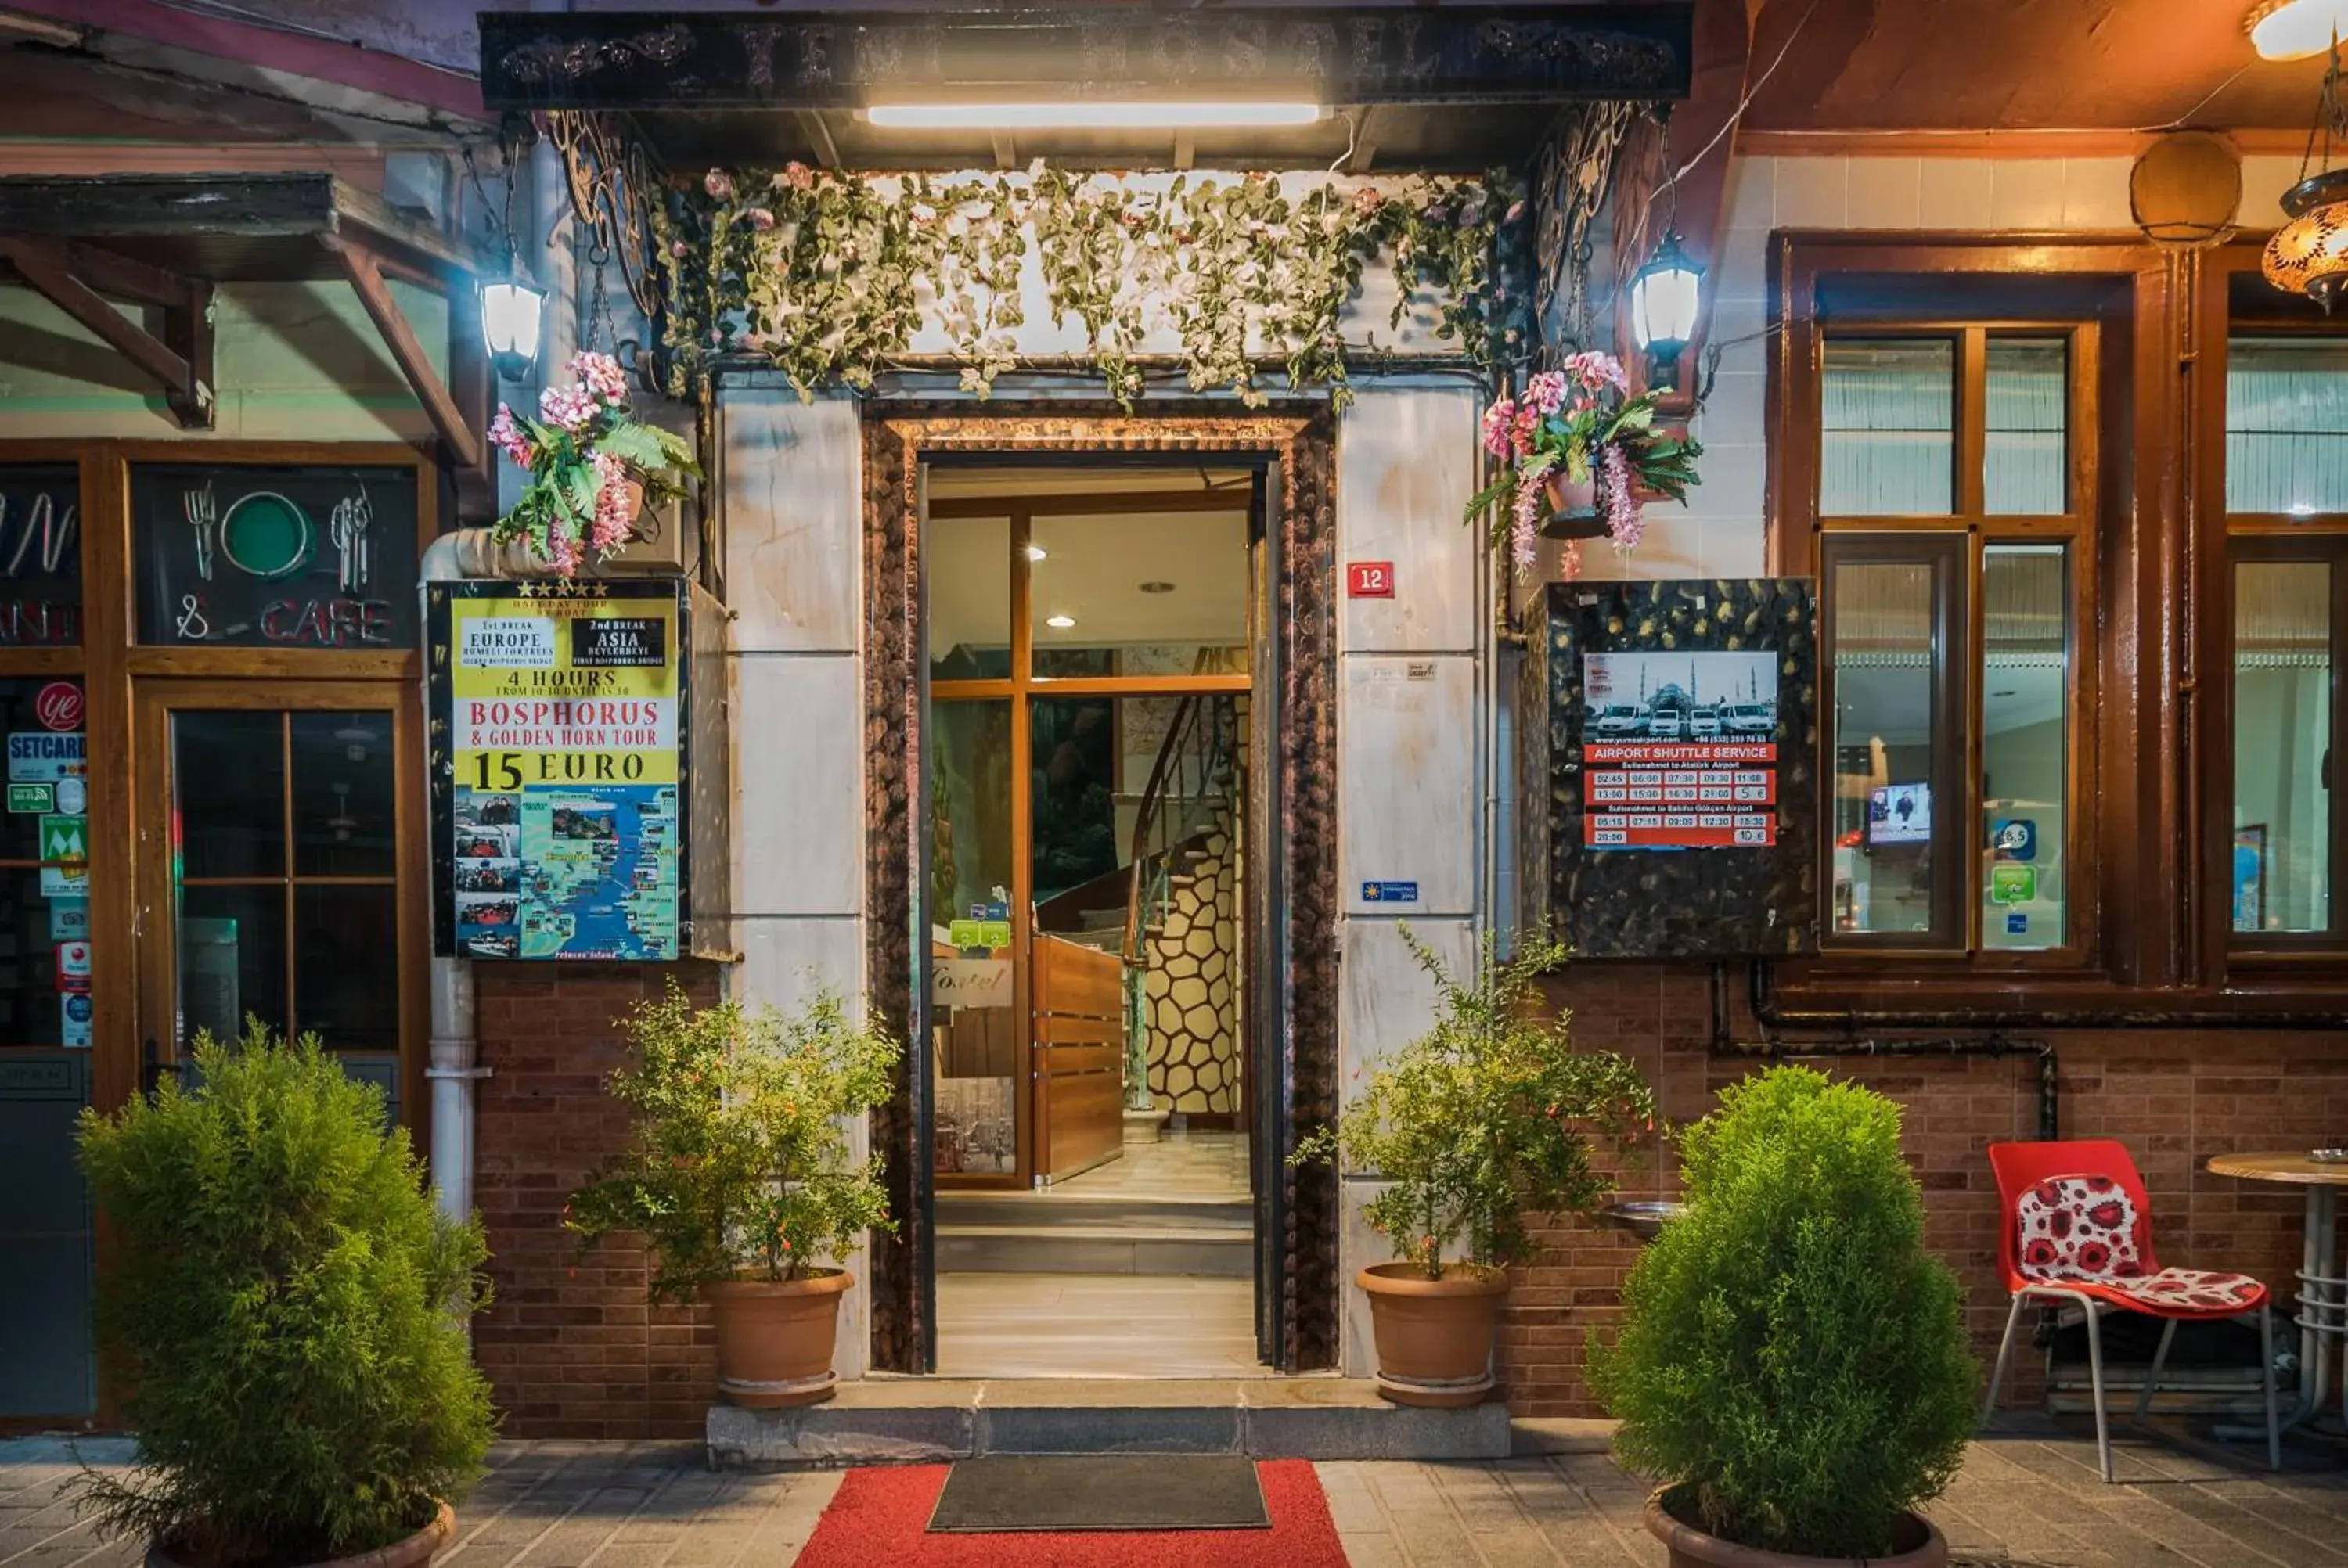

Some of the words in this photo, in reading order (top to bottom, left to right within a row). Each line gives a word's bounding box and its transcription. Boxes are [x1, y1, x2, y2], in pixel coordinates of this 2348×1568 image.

[1361, 569, 1382, 589] 12
[177, 594, 208, 638] &
[261, 599, 391, 646] CAFE
[502, 621, 533, 630] BREAK
[589, 620, 610, 631] 2nd
[613, 620, 646, 631] BREAK
[470, 633, 541, 647] EUROPE
[597, 632, 639, 647] ASIA
[508, 671, 519, 686] 4
[533, 671, 615, 686] HOURS
[495, 686, 528, 696] FROM
[564, 686, 596, 696] UNTIL
[470, 701, 658, 726] BOSPHORUS
[471, 729, 482, 746] &
[489, 729, 554, 746] GOLDEN
[561, 729, 606, 746] HORN
[612, 729, 657, 746] TOUR
[1594, 747, 1651, 758] AIRPORT
[1652, 747, 1710, 758] SHUTTLE
[1713, 747, 1767, 758] SERVICE
[475, 752, 524, 790] 15
[538, 753, 644, 780] EURO
[1712, 761, 1740, 770] Airport
[1741, 787, 1749, 799] 5
[1740, 830, 1752, 841] 10
